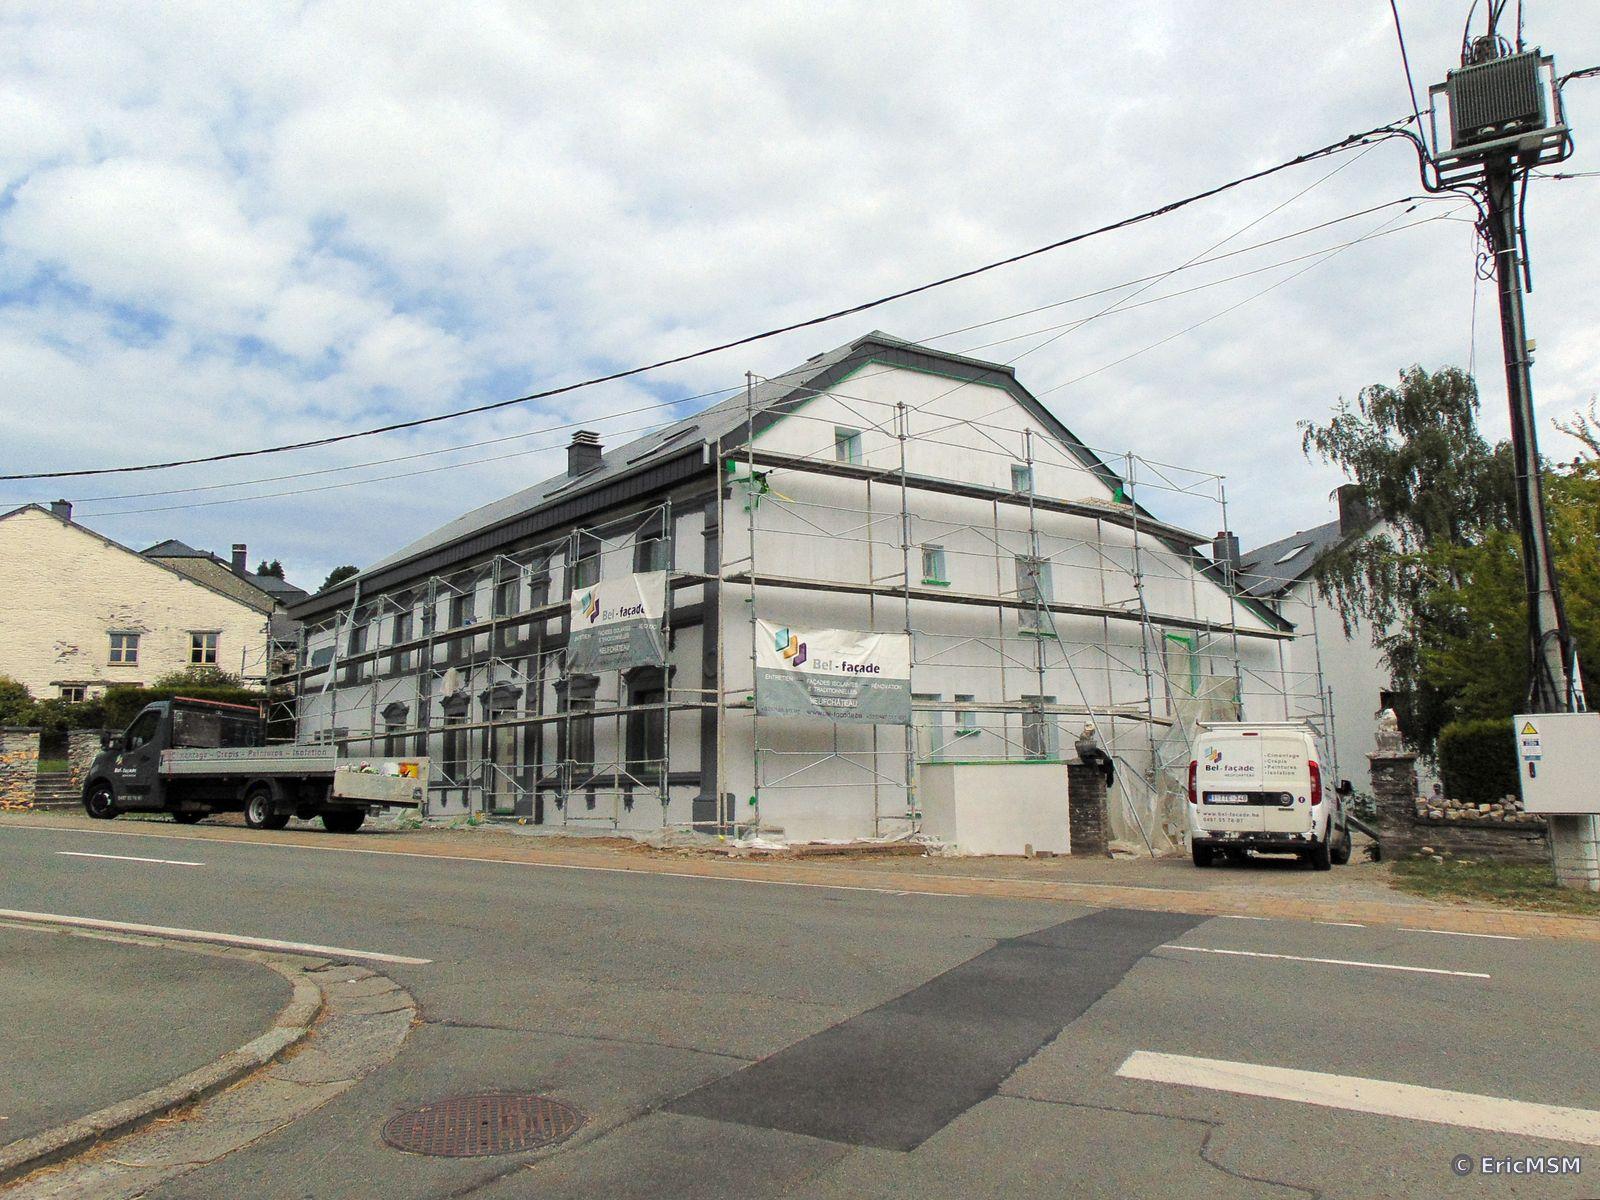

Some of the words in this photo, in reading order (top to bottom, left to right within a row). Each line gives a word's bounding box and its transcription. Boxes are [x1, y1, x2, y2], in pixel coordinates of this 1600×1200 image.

[602, 609, 615, 621] Bel
[812, 658, 832, 671] Bel
[841, 661, 881, 675] façade
[764, 673, 795, 683] ENTRETIEN
[292, 749, 327, 757] Isolation
[1205, 764, 1219, 772] Bel
[1224, 764, 1255, 773] façade
